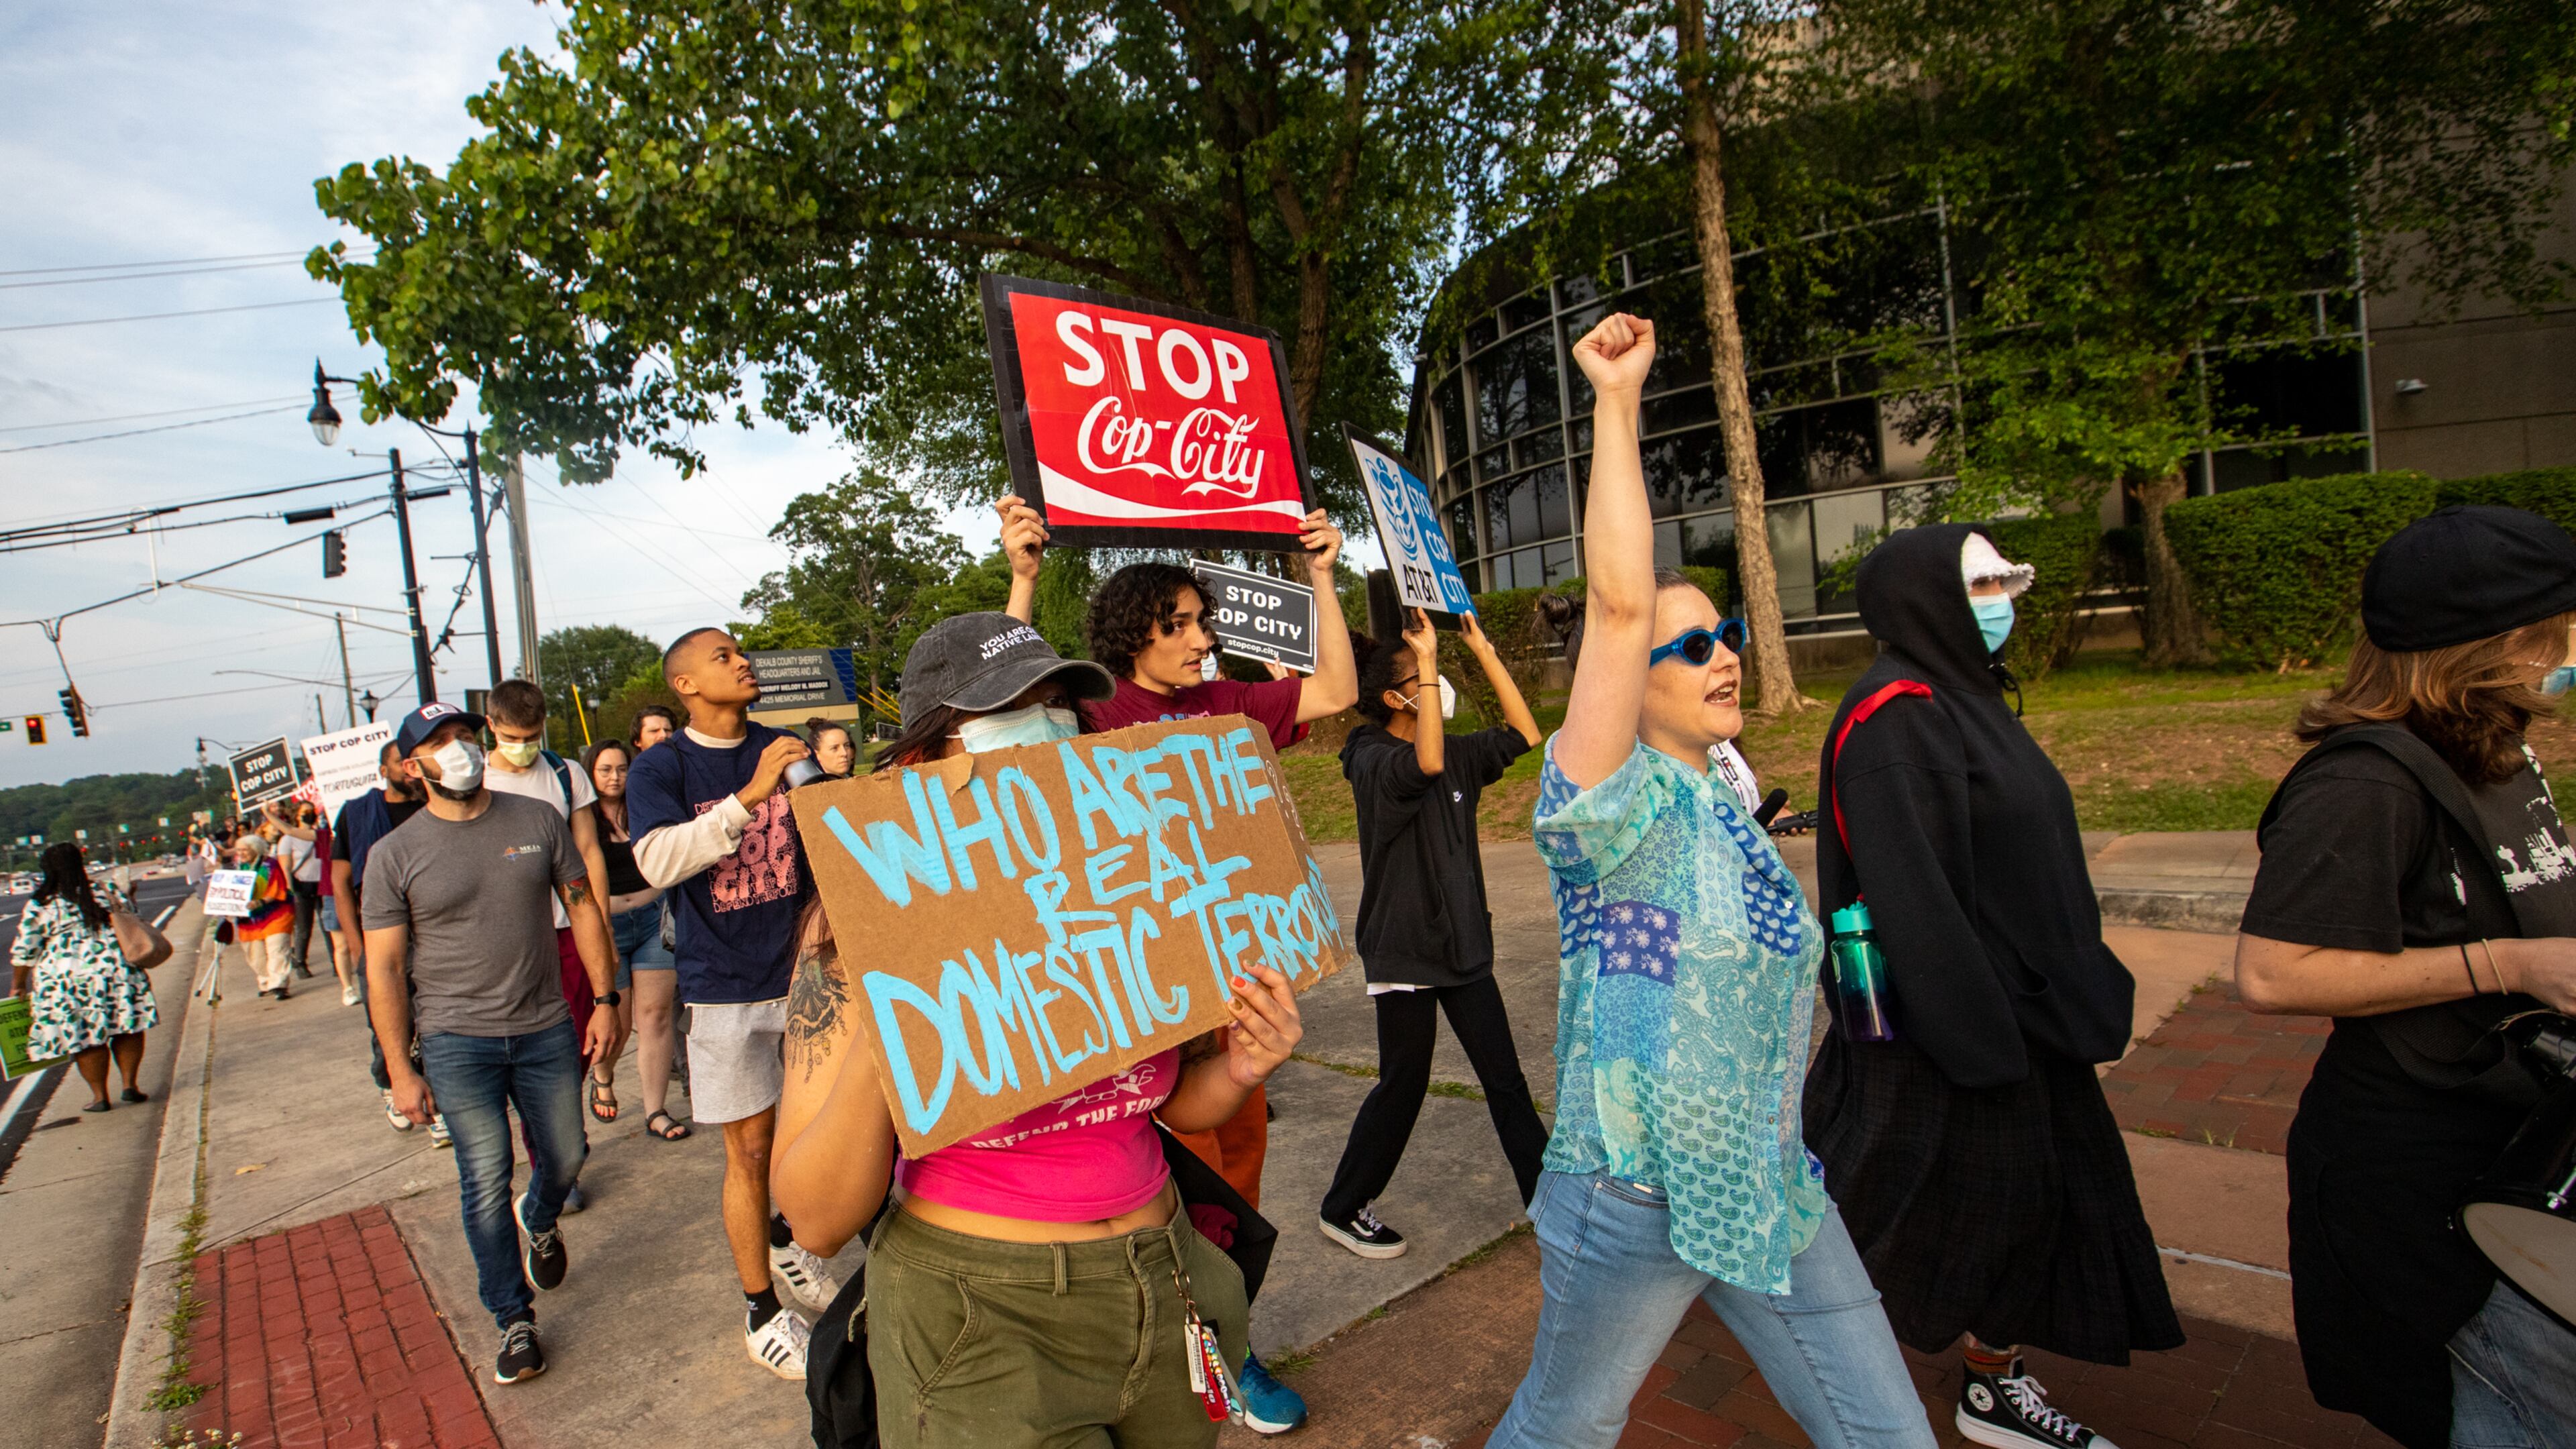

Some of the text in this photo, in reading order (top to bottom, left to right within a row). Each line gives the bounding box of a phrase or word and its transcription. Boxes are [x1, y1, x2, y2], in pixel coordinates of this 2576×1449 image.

[1055, 310, 1249, 403] STOP
[1426, 529, 1452, 564] COP
[1403, 564, 1439, 604] AT&T
[1441, 572, 1471, 606] CITY
[1226, 585, 1282, 610] STOP
[979, 633, 1006, 651] YOU
[1007, 627, 1026, 639] ARE
[1254, 615, 1302, 641] CITY
[981, 636, 1023, 660] NATIVE
[1227, 639, 1280, 659] stopcop.city
[755, 658, 776, 667] DEKALB
[777, 657, 798, 666] COUNTY
[759, 666, 822, 678] HEADQUARTERS AND JAIL
[774, 694, 806, 703] MEMORIAL
[807, 692, 826, 700] DRIVE
[780, 684, 801, 692] MELODY
[309, 729, 389, 755] STOP COP CITY
[245, 753, 274, 773] STOP
[239, 765, 288, 793] COP CITY
[323, 772, 378, 794] TORTUGUITA
[822, 765, 1061, 910] WHO
[1057, 740, 1190, 850] ARE
[1158, 727, 1276, 830] THE
[714, 854, 792, 902] CITY
[1024, 820, 1252, 945] REAL
[712, 895, 754, 913] DEFEND
[861, 906, 1190, 1135] DOMESTIC
[1075, 1105, 1118, 1127] THE
[1124, 1092, 1169, 1118] FOR
